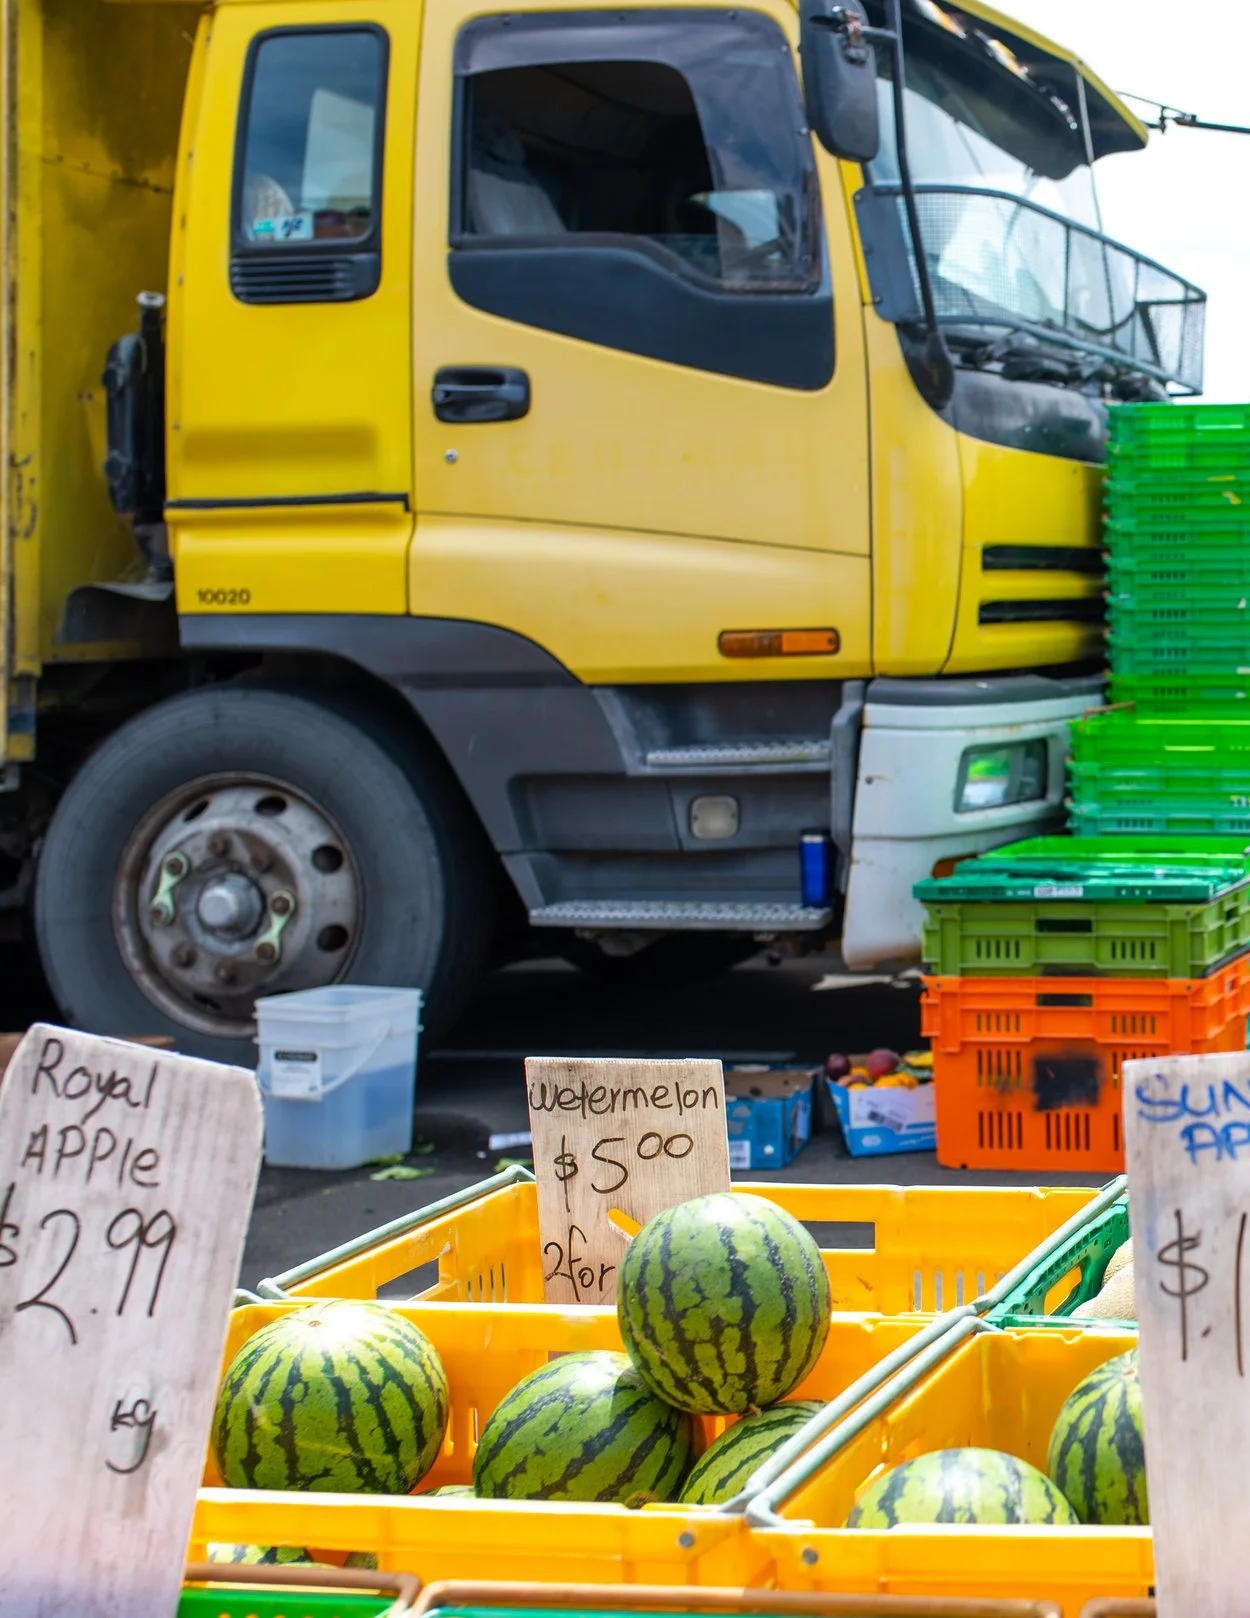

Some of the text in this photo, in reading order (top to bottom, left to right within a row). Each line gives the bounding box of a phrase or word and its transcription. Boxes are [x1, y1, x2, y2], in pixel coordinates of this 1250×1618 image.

[197, 588, 252, 606] 10020
[31, 1037, 158, 1125] Royal
[104, 1398, 158, 1475] kg
